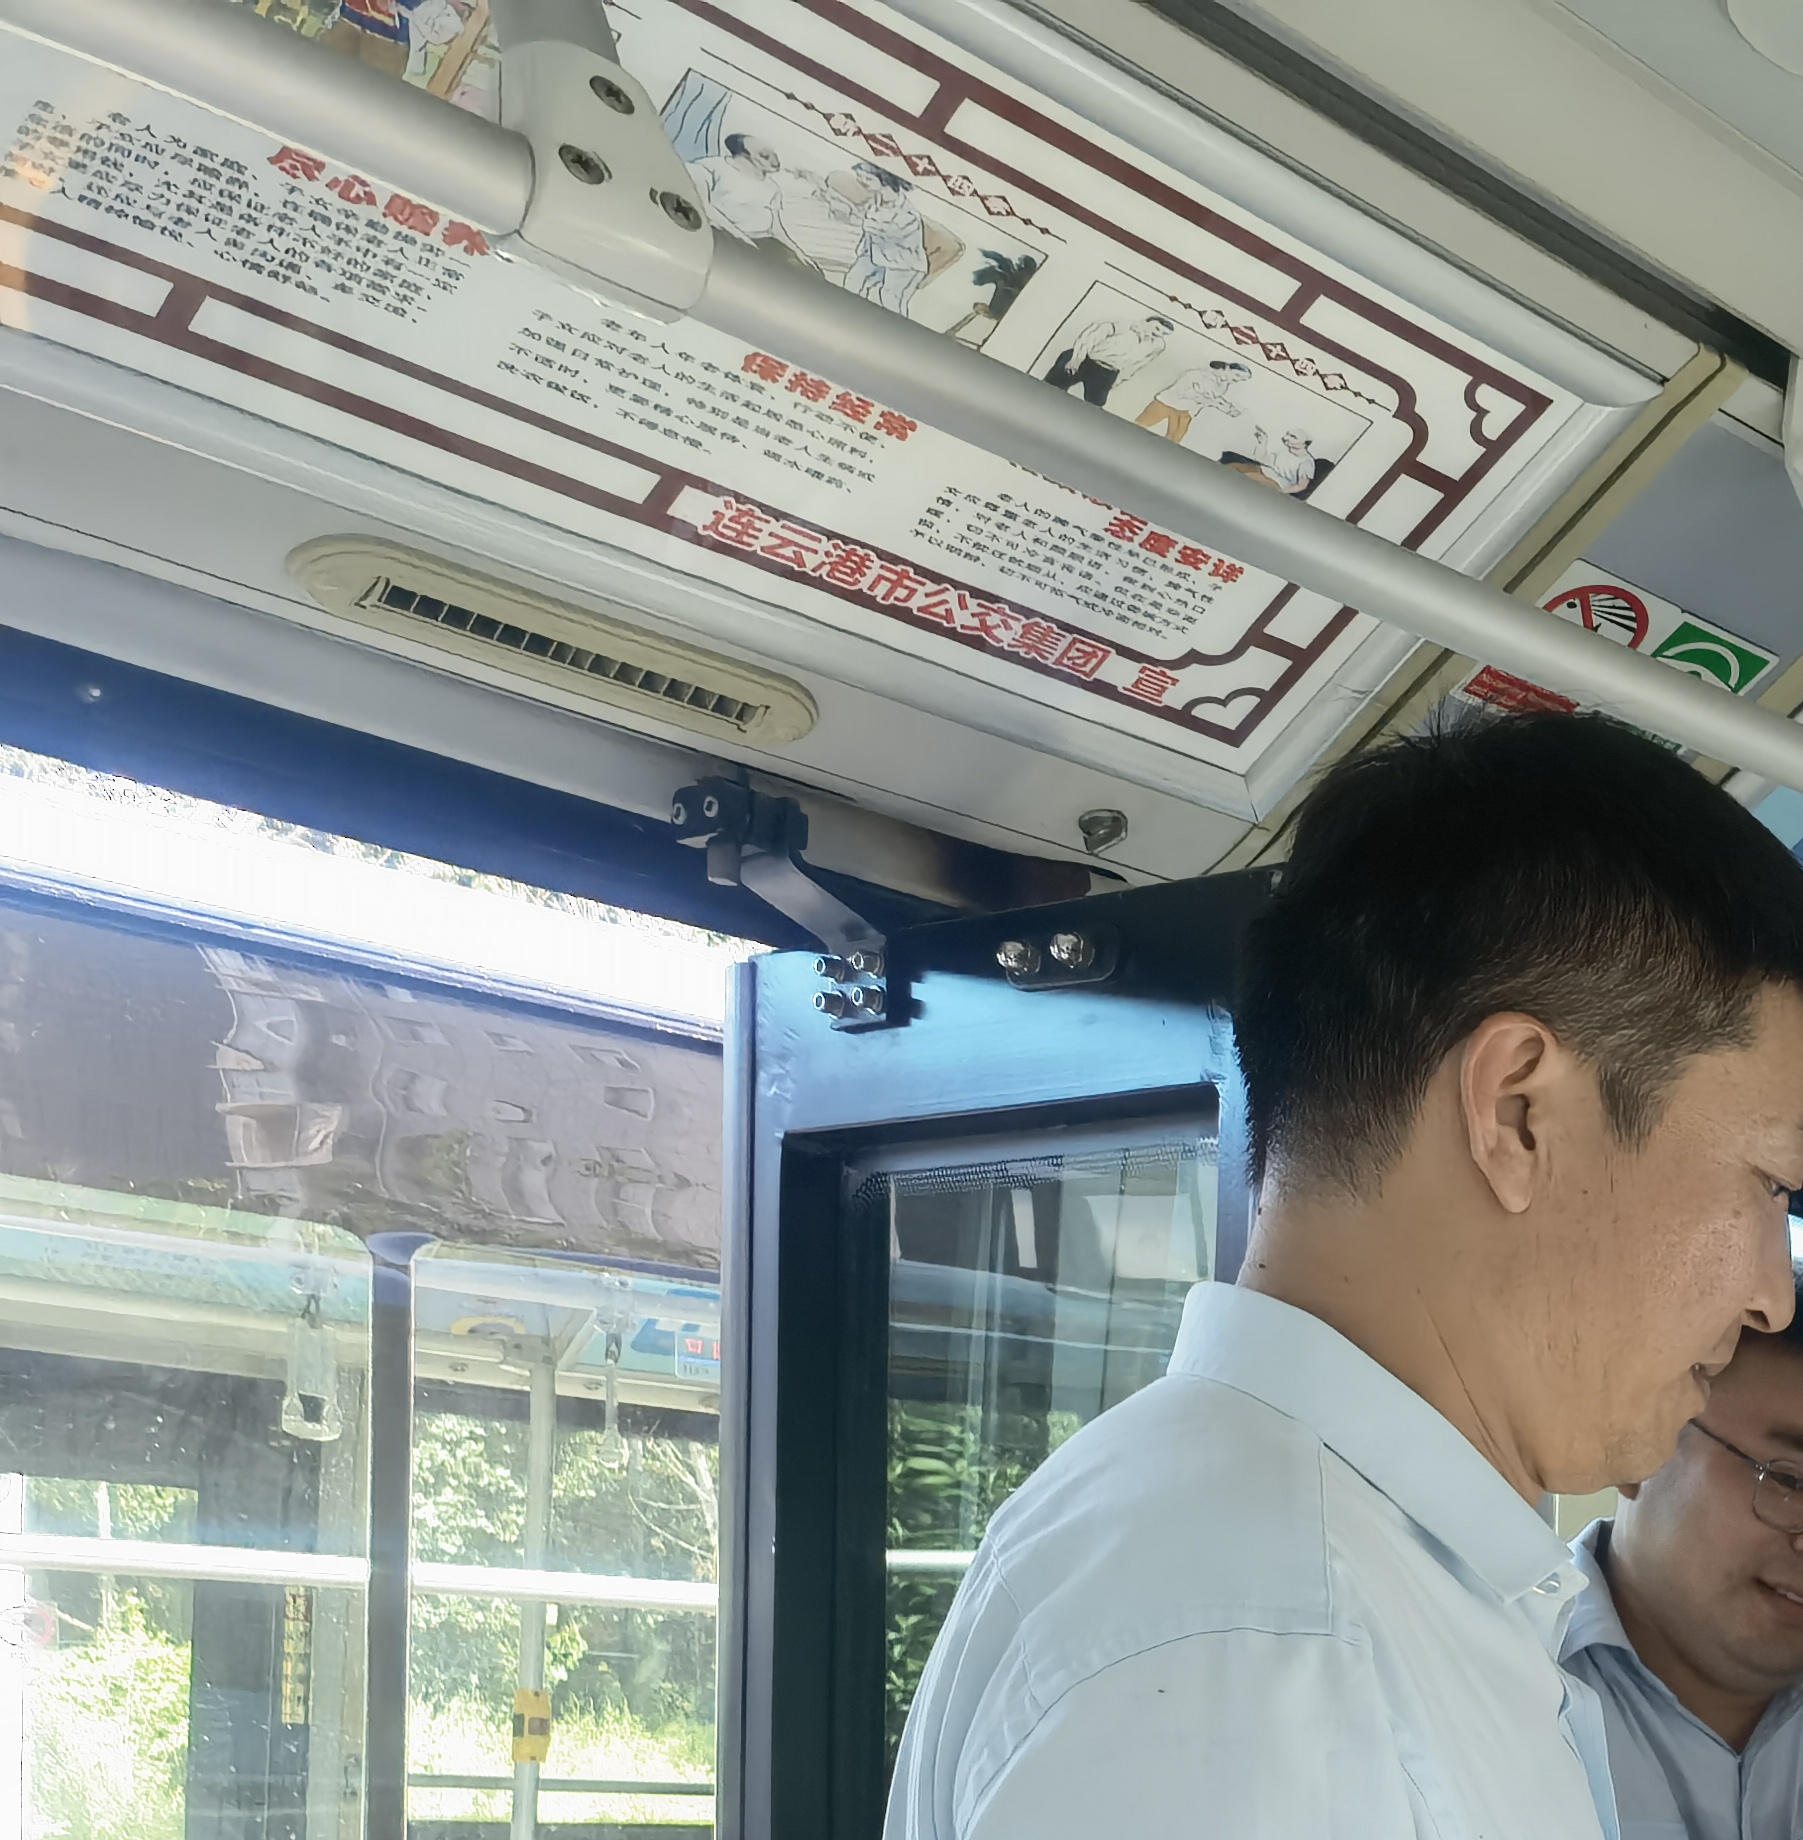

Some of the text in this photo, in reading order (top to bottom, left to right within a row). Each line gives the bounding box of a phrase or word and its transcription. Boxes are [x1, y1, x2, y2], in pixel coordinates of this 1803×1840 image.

[694, 494, 1179, 707] 连云港市公交集团 宣
